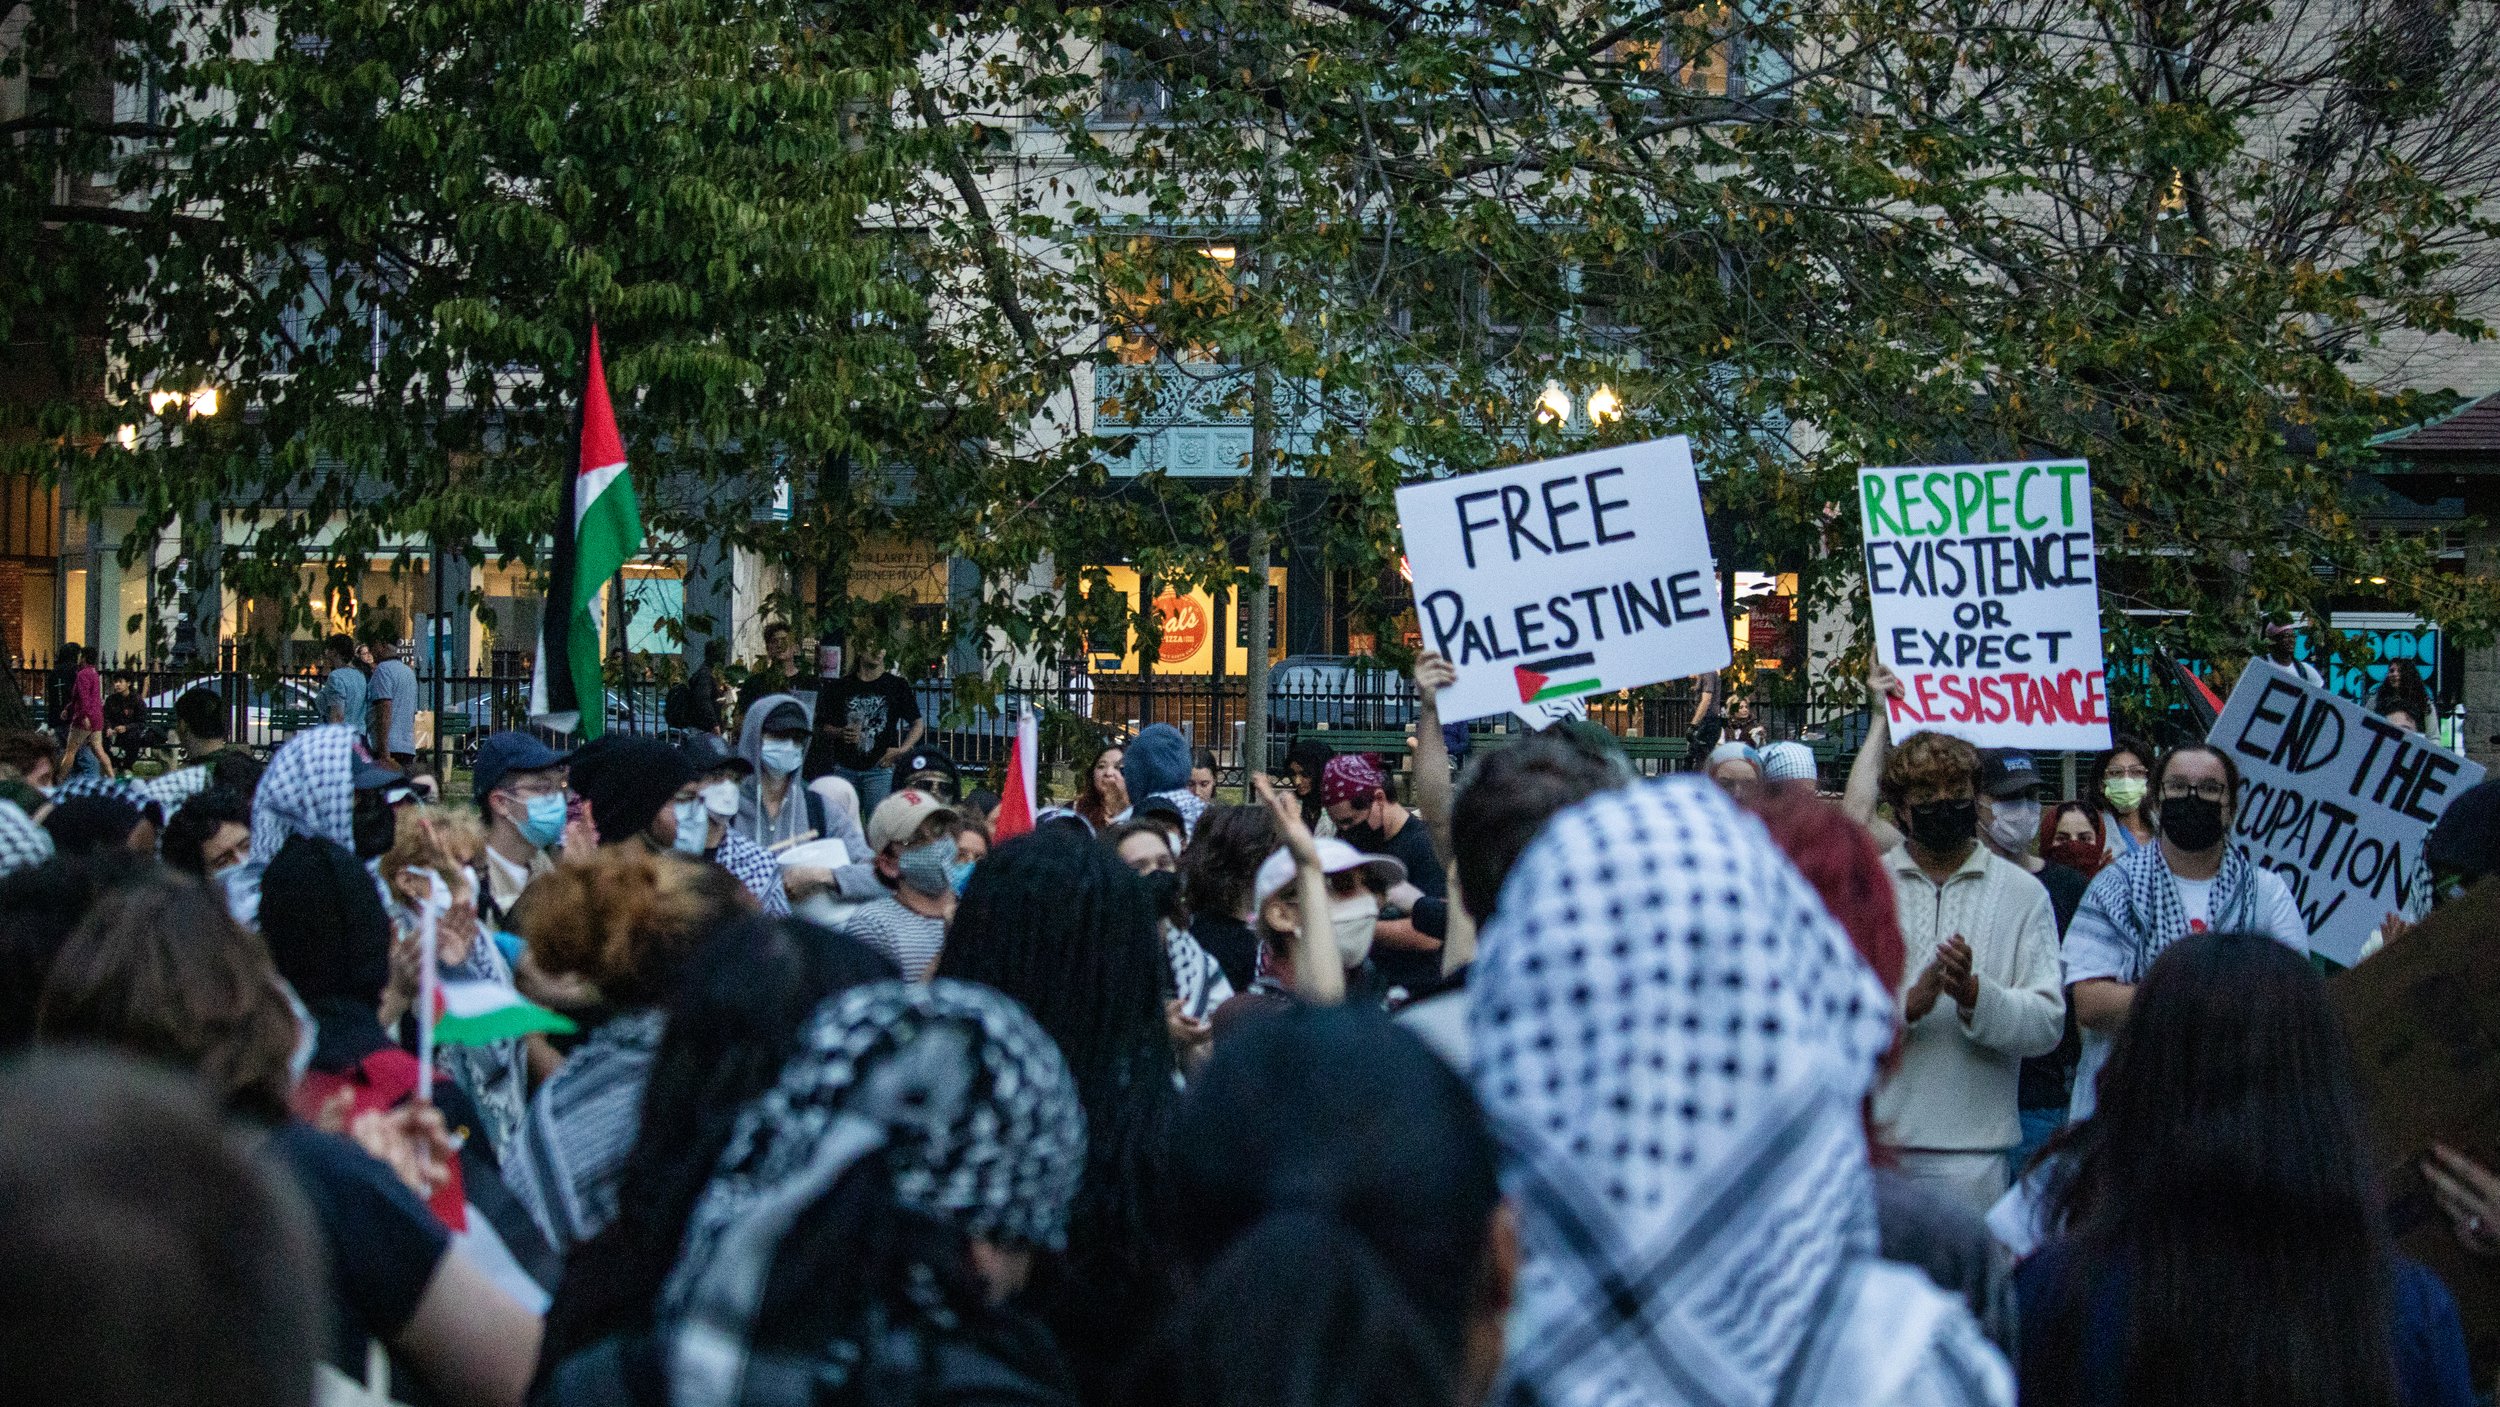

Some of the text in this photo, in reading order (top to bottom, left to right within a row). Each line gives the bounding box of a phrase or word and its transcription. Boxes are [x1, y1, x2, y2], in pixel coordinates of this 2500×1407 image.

[1454, 466, 1635, 569] FREE
[1862, 466, 2087, 537] RESPECT
[1866, 532, 2092, 598] EXISTENCE
[1422, 570, 1711, 666] PALESTINE
[1891, 627, 2072, 669] EXPECT
[1953, 600, 2011, 630] OR
[2235, 678, 2345, 775] END
[2348, 715, 2460, 824] THE
